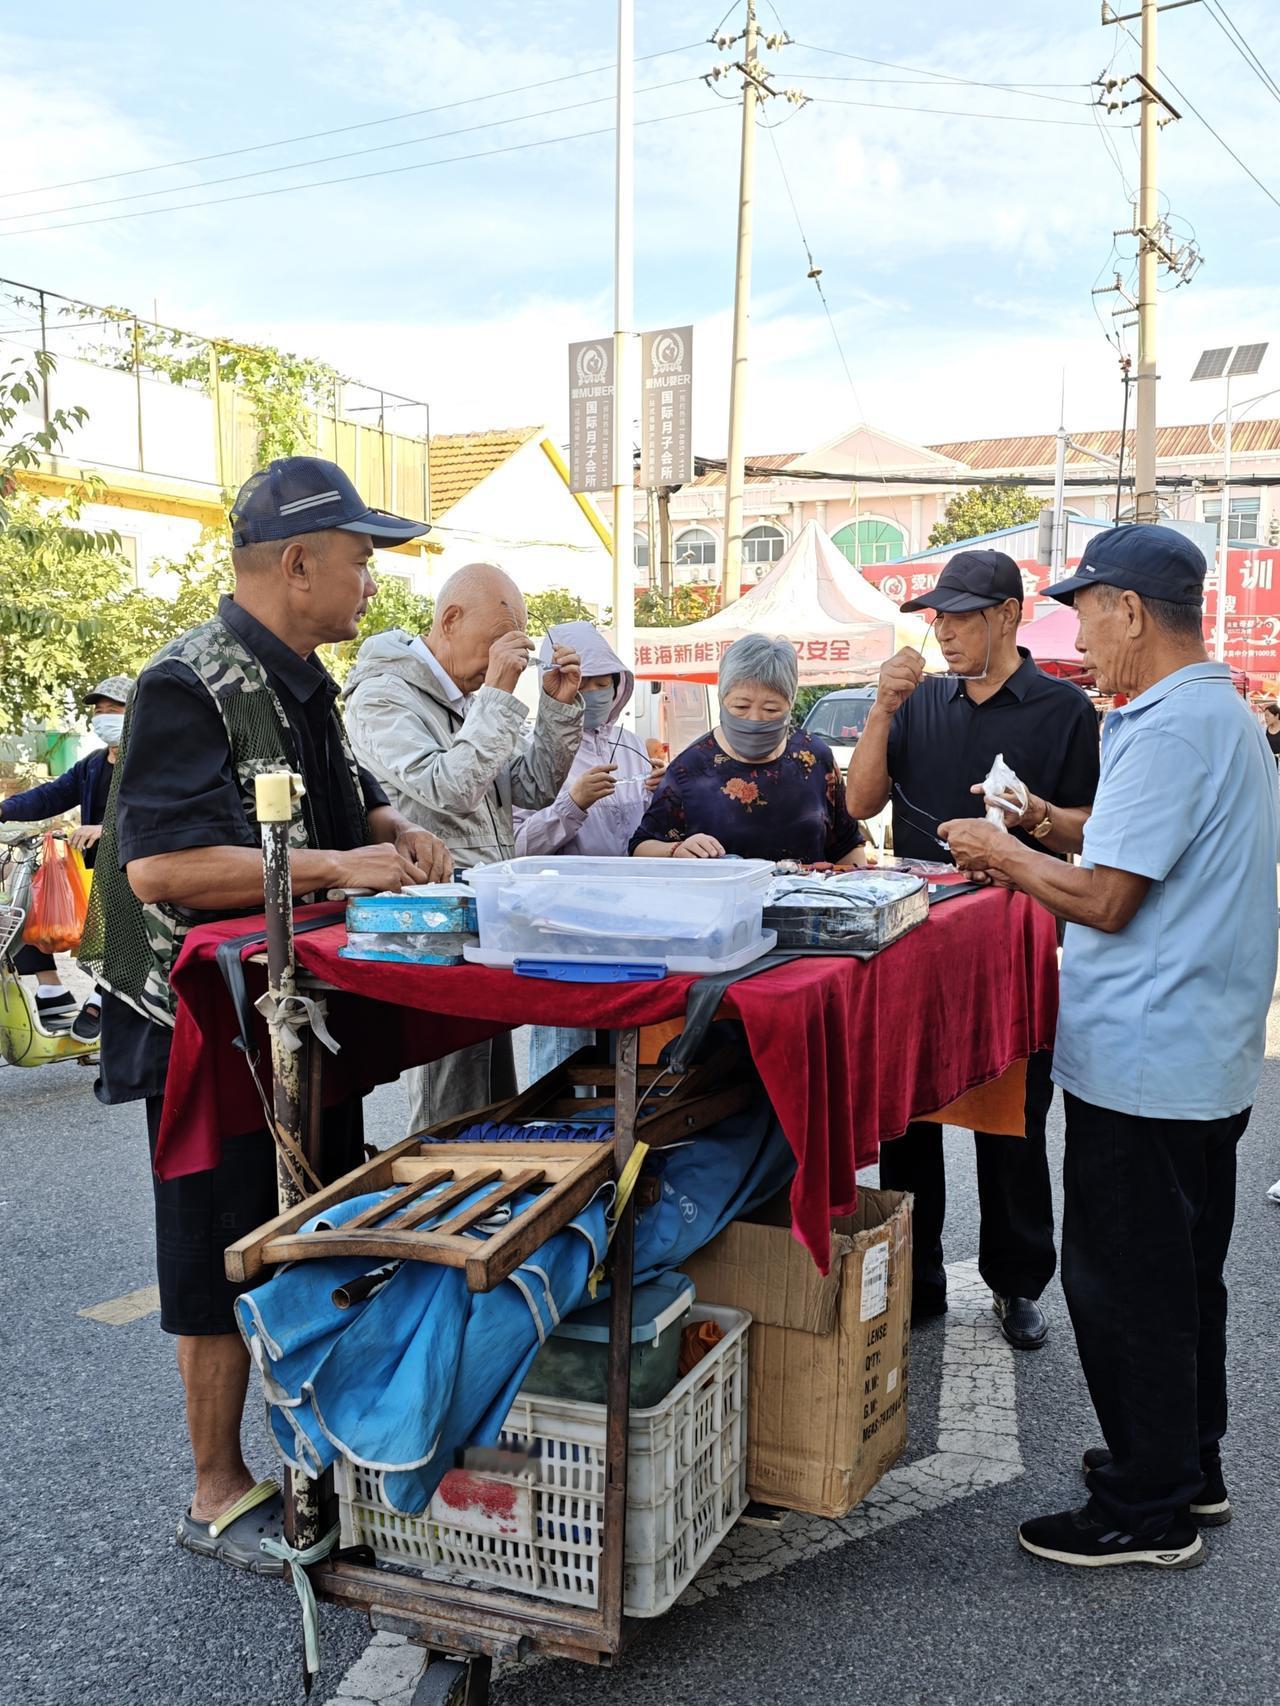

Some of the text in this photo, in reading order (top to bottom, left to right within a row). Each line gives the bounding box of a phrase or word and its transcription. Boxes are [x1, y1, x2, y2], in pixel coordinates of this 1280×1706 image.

[585, 400, 598, 488] 国际月子会所
[661, 390, 674, 480] 国际月子会所
[867, 1322, 888, 1347] LENSE
